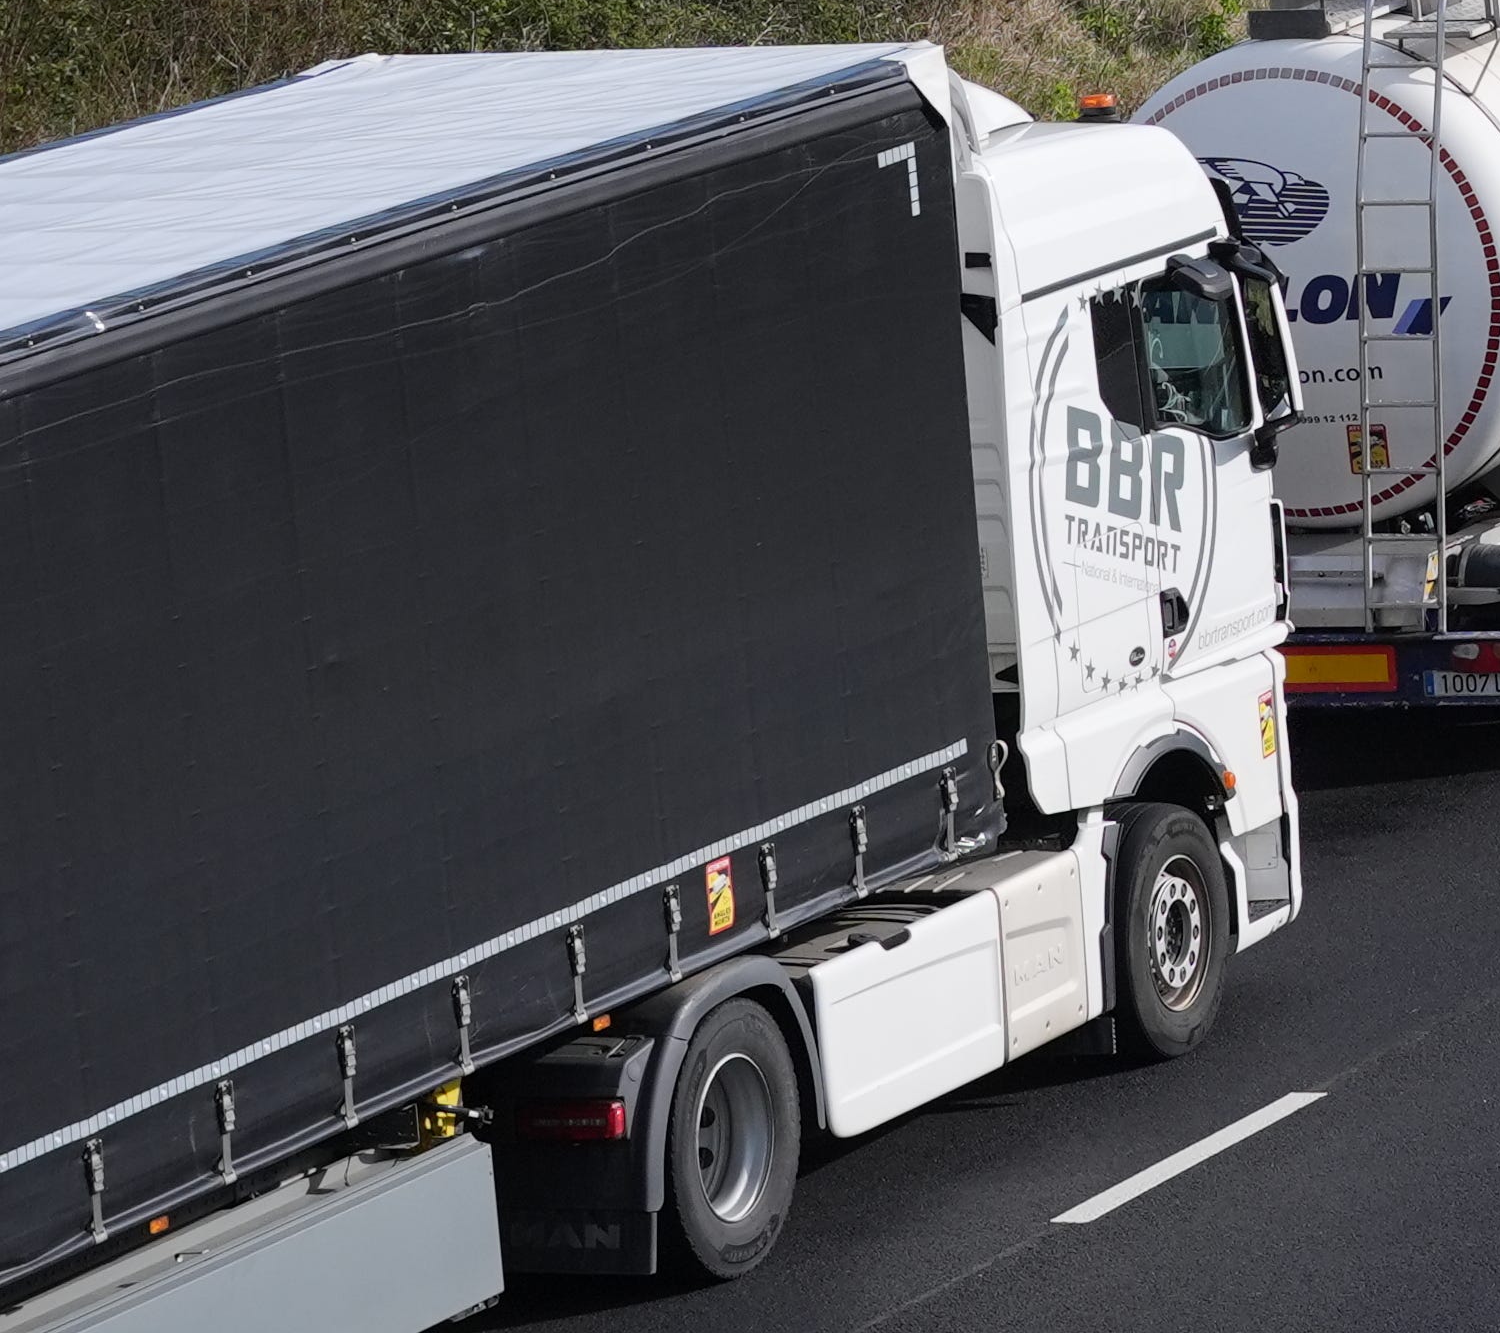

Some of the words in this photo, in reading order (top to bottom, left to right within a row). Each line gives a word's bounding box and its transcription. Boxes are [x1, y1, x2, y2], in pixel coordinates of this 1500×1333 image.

[1325, 415, 1336, 423] 12
[1339, 414, 1359, 422] 112
[1065, 405, 1185, 533] BBR
[1064, 514, 1181, 574] TRANSPORT
[1441, 674, 1490, 694] 1007
